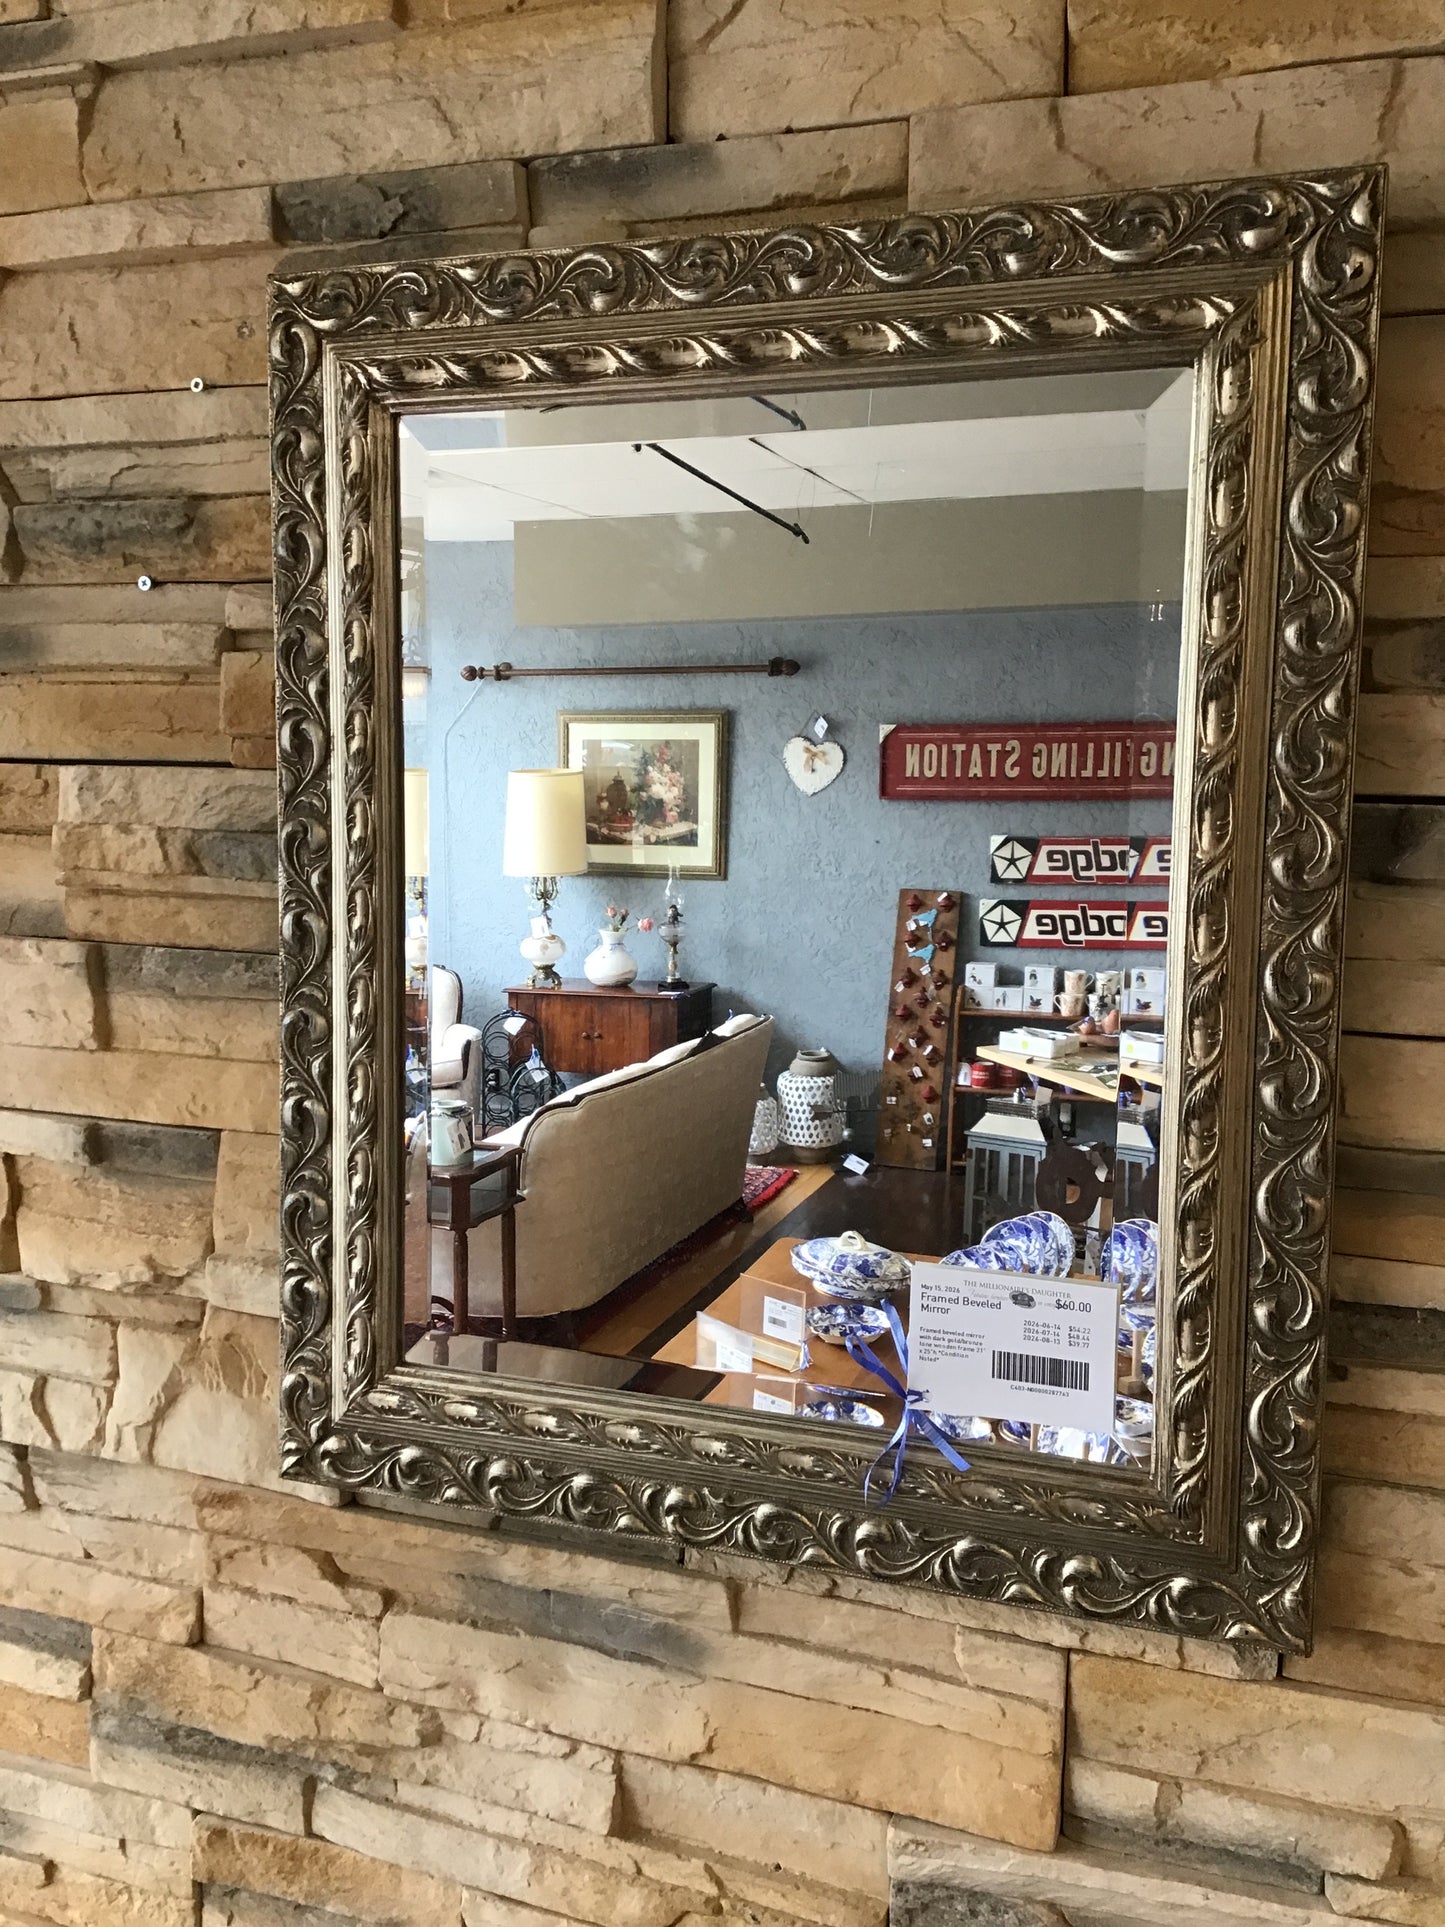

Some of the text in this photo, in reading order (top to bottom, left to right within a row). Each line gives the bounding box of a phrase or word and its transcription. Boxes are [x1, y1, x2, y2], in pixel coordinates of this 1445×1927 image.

[921, 1283, 933, 1291] May
[944, 1286, 960, 1294] 2026
[1032, 1288, 1071, 1299] DAUGHTER
[920, 1291, 960, 1306] Framed
[962, 1296, 1002, 1310] Beveled
[1055, 1298, 1092, 1313] $60.00
[920, 1303, 951, 1315] Mirror
[919, 1326, 942, 1335] Framed
[942, 1328, 965, 1337] beveled
[1023, 1320, 1091, 1335] 2026-06-14 $54.22
[1023, 1327, 1060, 1338] 2026-07-14
[1022, 1334, 1090, 1348] 2026-08-13 $39.77
